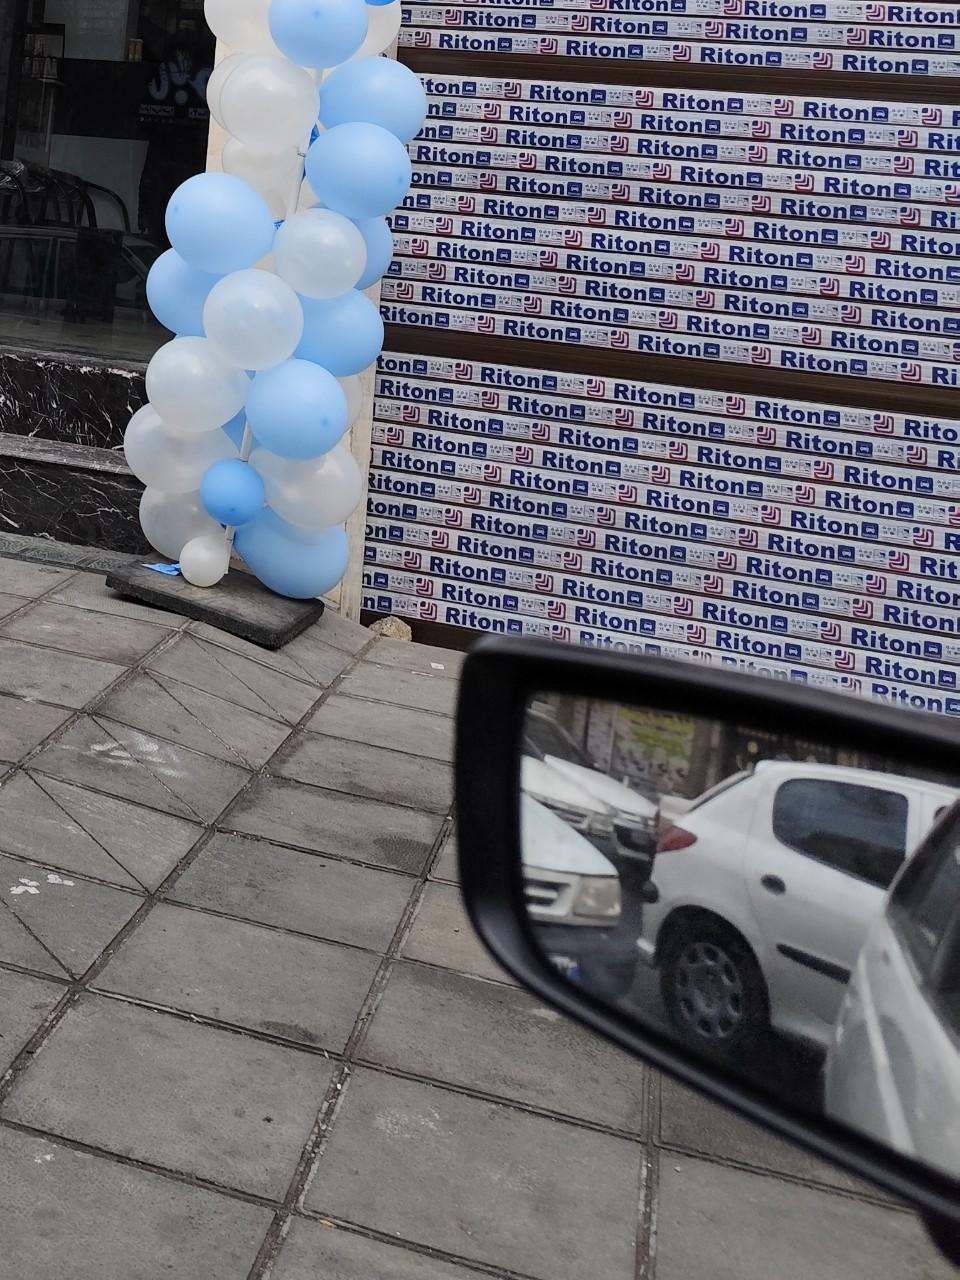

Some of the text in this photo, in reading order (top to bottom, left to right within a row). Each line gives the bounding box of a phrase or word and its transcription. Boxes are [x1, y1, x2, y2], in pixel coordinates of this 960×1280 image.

[464, 11, 935, 48] Riton Riton Riton Riton
[744, 0, 808, 18] Riton
[888, 5, 954, 23] Riton
[439, 34, 909, 73] Riton Riton Riton Riton
[510, 106, 846, 142] Riton Riton Riton
[530, 84, 869, 120] Riton Riton Riton
[417, 146, 891, 197] Riton Riton Riton Riton
[506, 129, 842, 168] Riton Riton Riton
[484, 199, 818, 242] Riton Riton Riton
[506, 176, 847, 220] Riton Riton Riton
[437, 242, 918, 303] Riton Riton Riton Riton
[461, 220, 943, 280] Riton Riton Riton Riton
[422, 287, 898, 354] Riton Riton Riton Riton
[454, 267, 940, 332] Riton Riton Riton Riton
[504, 320, 848, 372] Riton Riton Riton
[380, 380, 852, 454] Riton Riton Riton Riton
[481, 368, 820, 424] Riton Riton Riton
[412, 432, 894, 515] Riton Riton Riton Riton
[428, 410, 913, 491] Riton Riton Riton Riton
[382, 451, 858, 536] Riton Riton Riton Riton
[471, 513, 813, 582] Riton Riton Riton
[490, 491, 835, 559] Riton Riton Riton
[430, 556, 921, 656] Riton Riton Riton Riton
[458, 536, 955, 632] Riton Riton Riton Riton
[442, 583, 936, 685] Riton Riton Riton Riton
[446, 607, 505, 632] Riton
